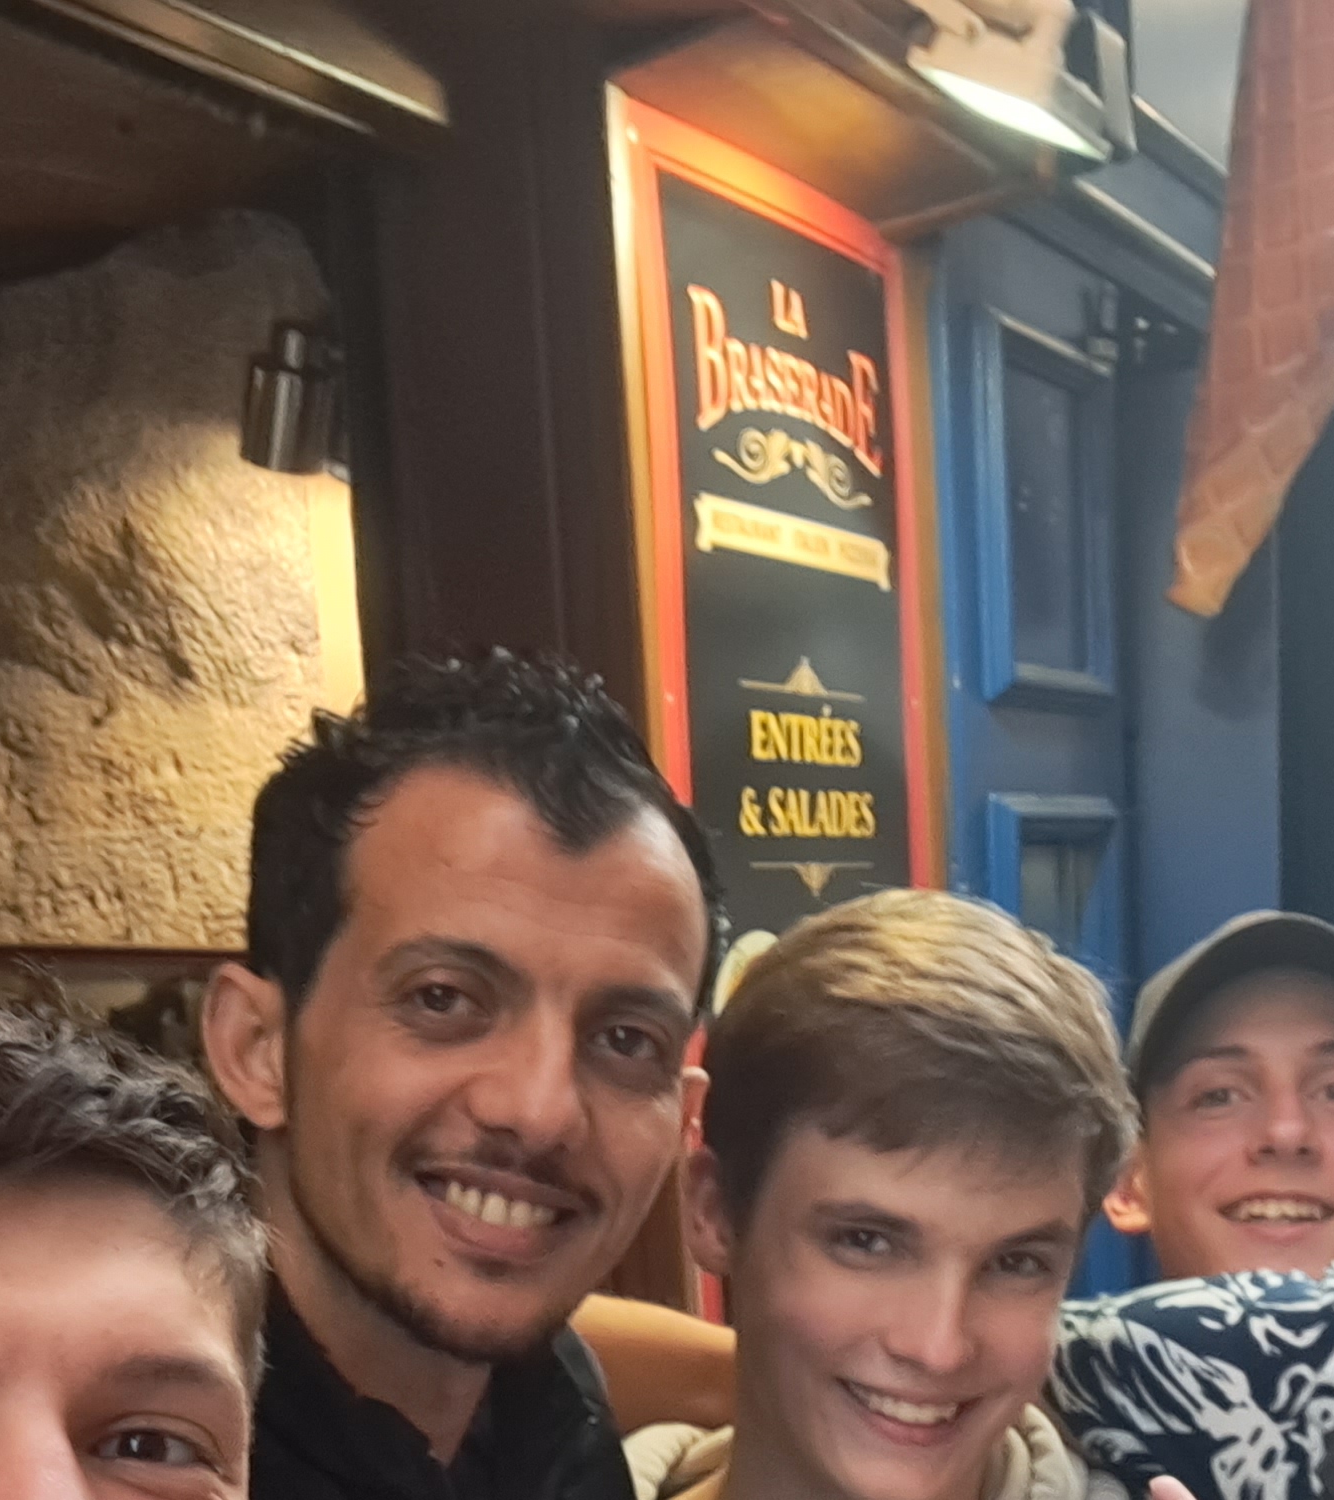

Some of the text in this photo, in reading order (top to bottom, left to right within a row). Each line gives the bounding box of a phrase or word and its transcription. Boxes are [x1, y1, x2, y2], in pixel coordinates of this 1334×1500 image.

[770, 278, 810, 341] LA
[686, 282, 884, 479] BRASERADE
[750, 703, 863, 768] ENTRÉES
[739, 786, 877, 839] & SALADES
